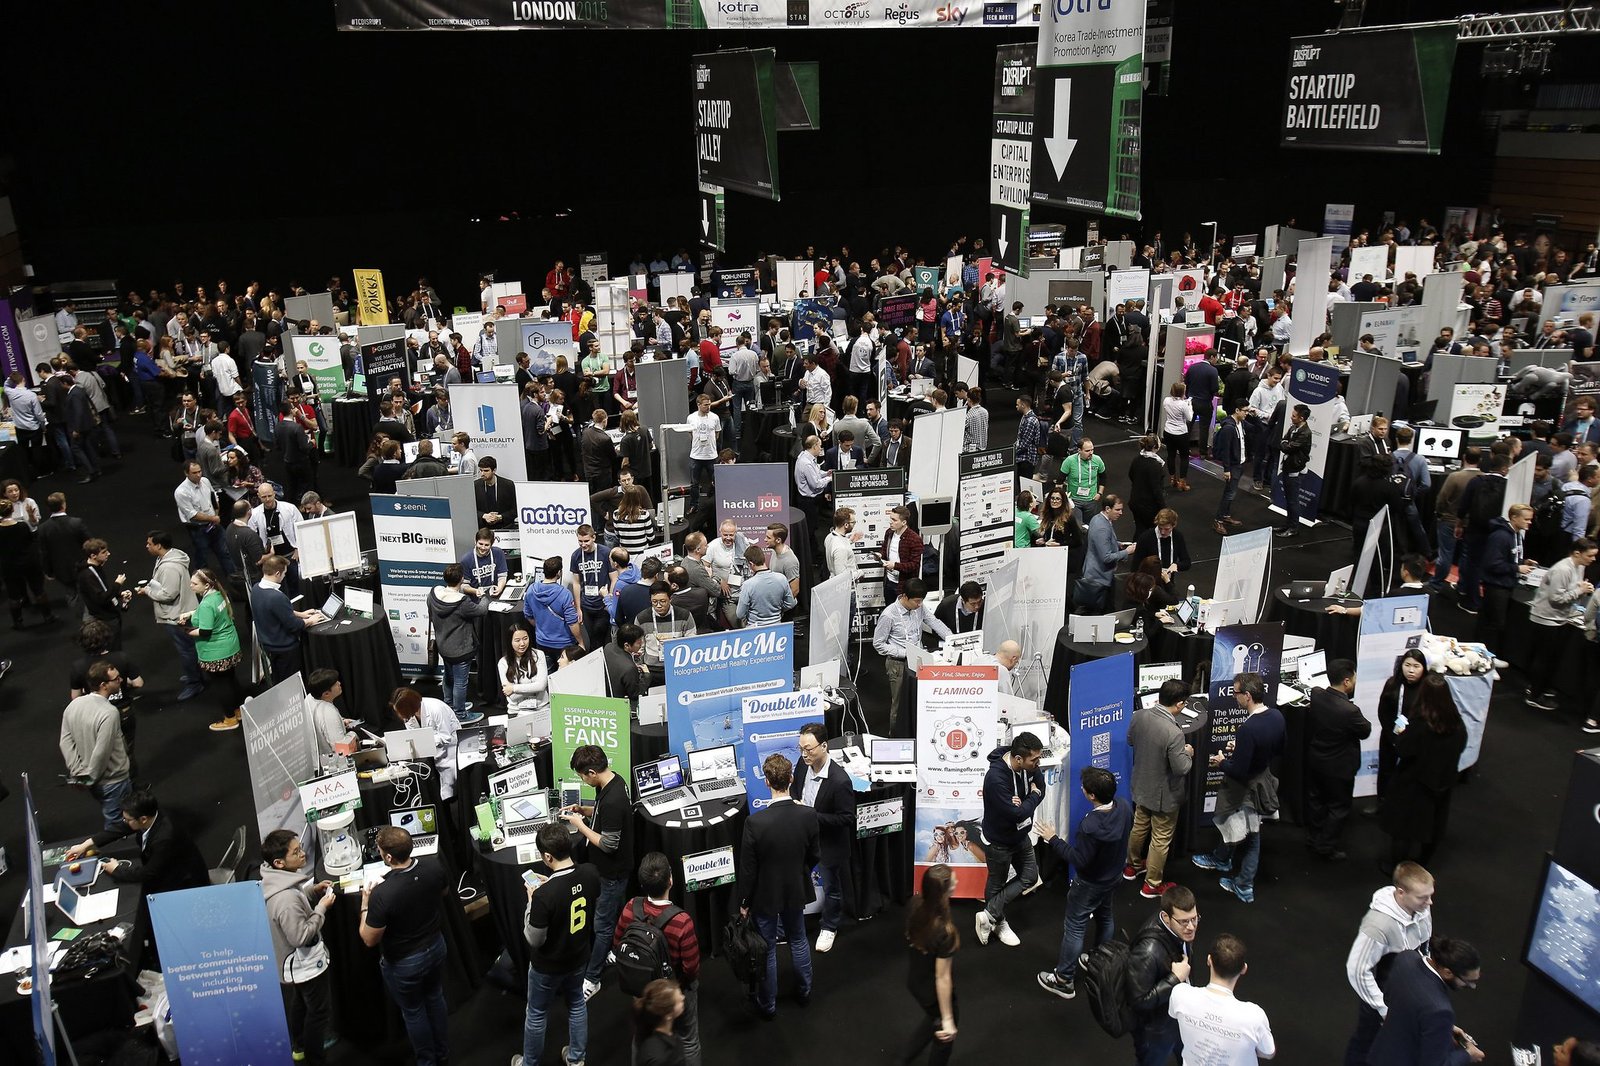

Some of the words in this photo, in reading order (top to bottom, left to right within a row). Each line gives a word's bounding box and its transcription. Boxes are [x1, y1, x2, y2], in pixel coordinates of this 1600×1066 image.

[718, 1, 759, 14] kotra
[824, 9, 870, 19] OCTOPUS
[884, 7, 920, 24] Regus
[936, 5, 968, 26] sky
[1054, 32, 1076, 43] Korea
[1077, 26, 1143, 40] Trade-Investment
[1054, 45, 1090, 56] Promotion
[1092, 44, 1117, 57] Agency
[1294, 48, 1322, 60] DISRUPT
[1002, 66, 1032, 86] DISRUPT
[1290, 74, 1356, 99] STARTUP
[698, 100, 732, 129] STARTUP
[1286, 104, 1380, 129] BATTLEFIELD
[996, 120, 1018, 134] STARTUP
[700, 133, 720, 162] ALLEY
[1002, 144, 1028, 162] CAPITAL
[993, 164, 1030, 184] ENTERPRIS
[1000, 184, 1030, 204] PAVILION
[724, 326, 756, 336] apwize
[368, 362, 406, 374] INTERACTIVE
[369, 357, 404, 368] PRESENTATIONS
[1307, 372, 1330, 384] YOOBIC
[402, 503, 428, 512] seenit
[723, 500, 756, 509] hacka
[760, 498, 778, 510] job
[521, 504, 587, 525] natter
[402, 532, 424, 544] BIG
[852, 614, 880, 627] RUPT
[670, 632, 788, 668] DoubleMe
[673, 666, 708, 677] Holographic
[710, 662, 728, 670] Virtual
[730, 659, 749, 669] Reality
[750, 653, 786, 666] Experiences!
[1148, 673, 1180, 682] Keypair
[933, 687, 984, 696] FLAMINGO
[564, 707, 593, 715] ESSENTIAL
[748, 694, 818, 714] DoubleMe
[1094, 700, 1123, 712] Translations?
[1080, 714, 1110, 730] Flitto
[1112, 708, 1122, 722] it!
[1214, 709, 1227, 717] The
[564, 714, 617, 730] SPORTS
[1212, 726, 1229, 734] HSM
[1230, 725, 1236, 733] &
[564, 728, 618, 749] FANS
[508, 770, 532, 785] breeze
[510, 778, 530, 790] valley
[314, 781, 344, 798] AKA
[860, 812, 890, 822] FLAMINGO
[686, 856, 730, 874] DoubleMe
[572, 883, 582, 896] BO
[570, 896, 586, 935] 6
[200, 951, 212, 960] To
[212, 948, 234, 958] help
[168, 964, 196, 974] better
[198, 953, 269, 970] communication
[178, 970, 221, 982] between
[222, 968, 234, 976] all
[234, 963, 264, 976] things
[202, 975, 243, 988] including
[192, 988, 225, 1000] human
[226, 982, 258, 996] beings
[1204, 1012, 1222, 1024] 2015
